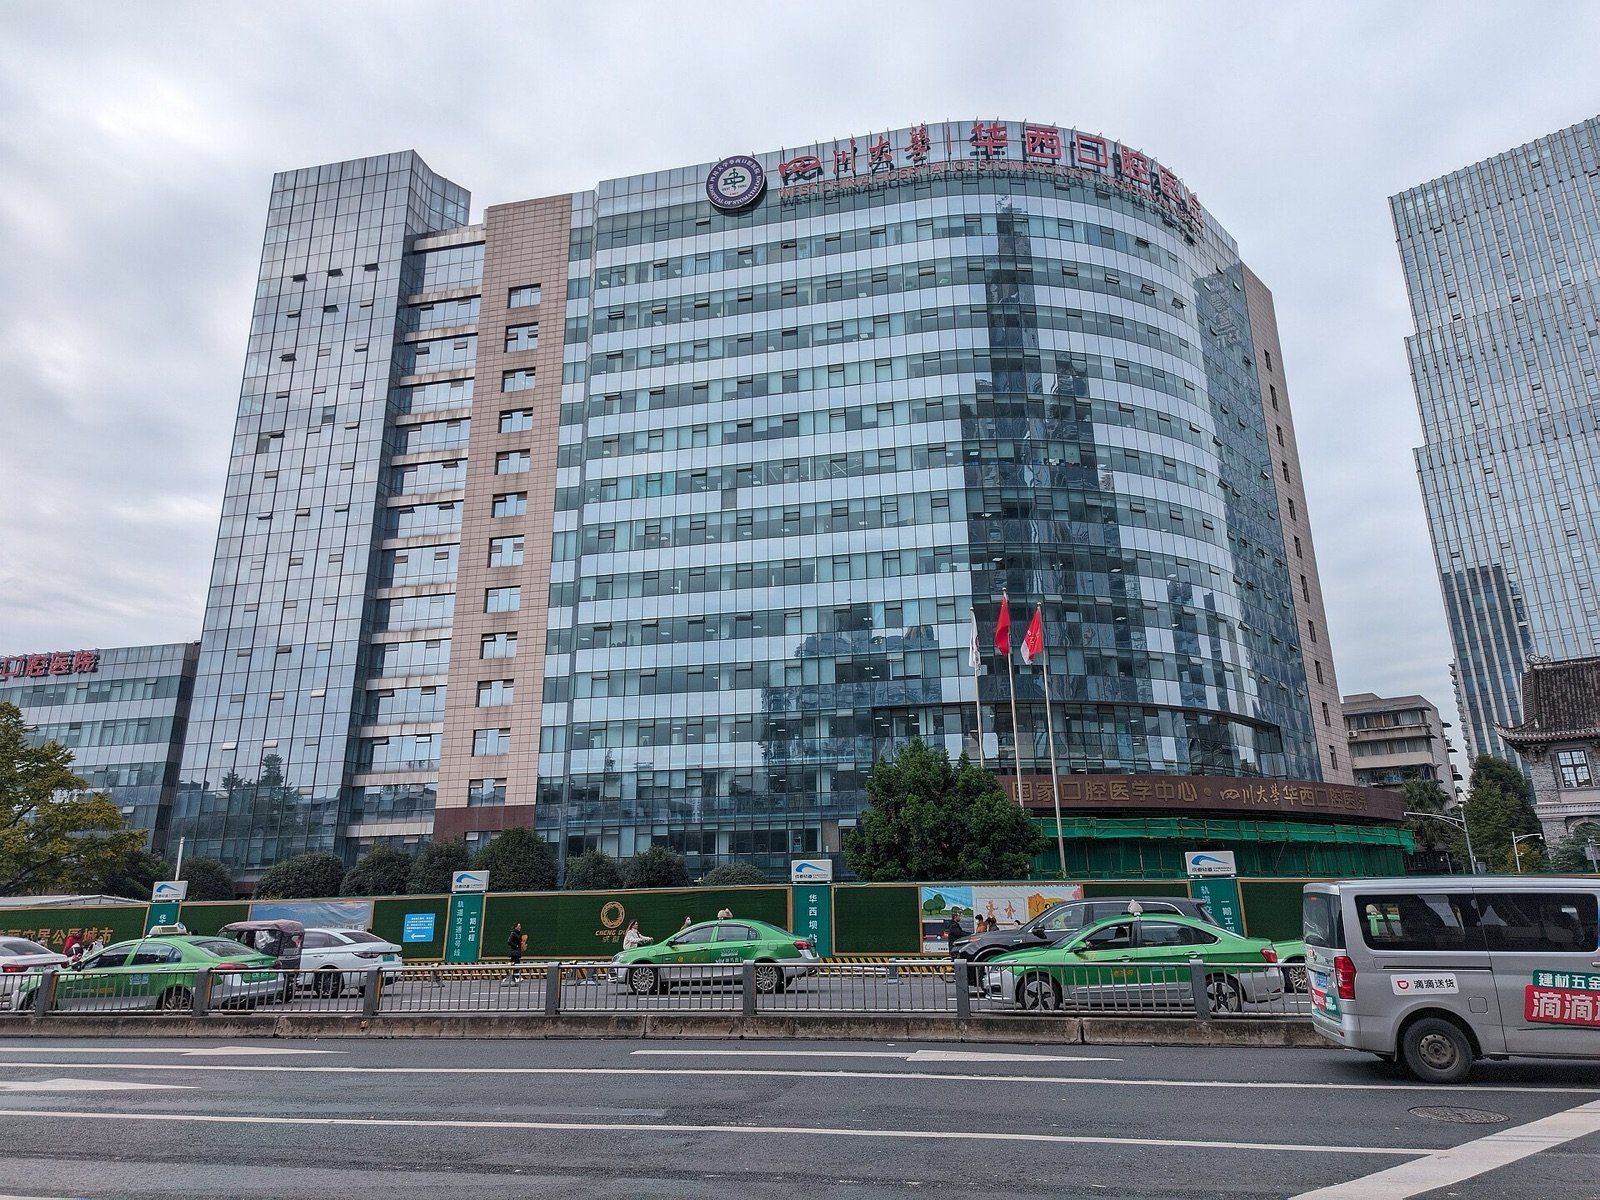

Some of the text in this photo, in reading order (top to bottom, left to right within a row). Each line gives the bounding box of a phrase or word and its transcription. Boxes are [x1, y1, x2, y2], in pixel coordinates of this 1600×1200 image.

[778, 183, 820, 199] WEST
[823, 176, 870, 194] CHINA
[954, 161, 975, 172] OF
[0, 652, 95, 677] 口腔医院
[1012, 780, 1198, 802] 国家口腔医学中心
[468, 911, 477, 942] 一期工程
[808, 893, 818, 944] 华西坝站
[1413, 979, 1456, 989] 滴滴送货
[1538, 972, 1600, 990] 建材五金
